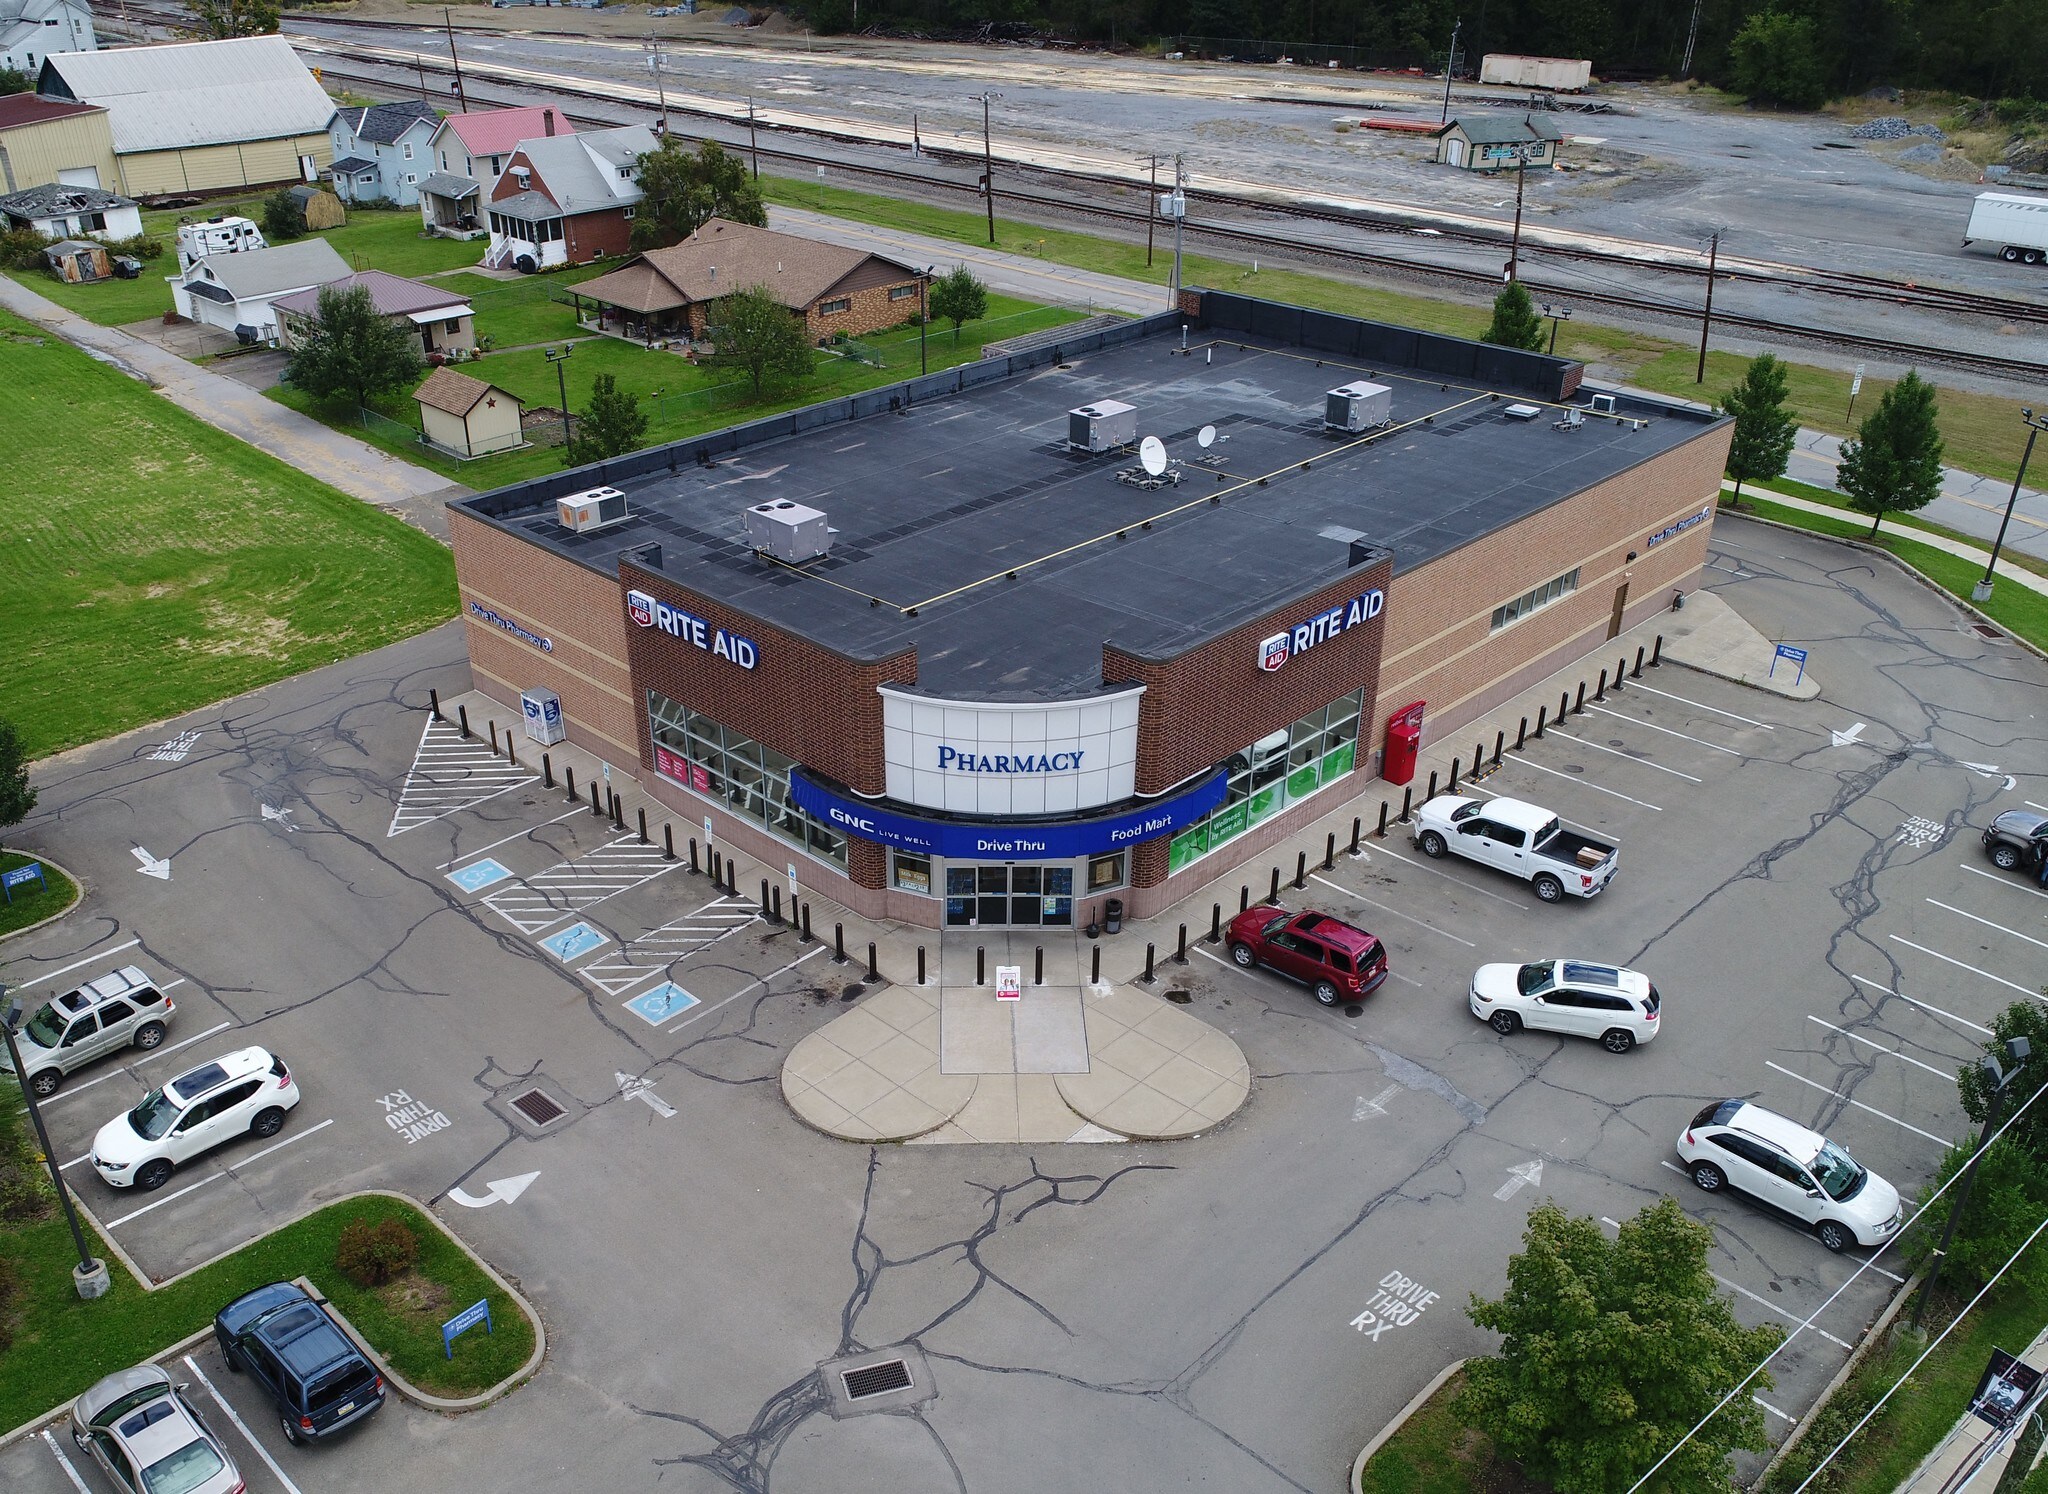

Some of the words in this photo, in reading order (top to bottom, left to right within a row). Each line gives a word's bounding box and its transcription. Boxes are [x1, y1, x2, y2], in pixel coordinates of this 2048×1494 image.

[1649, 533, 1664, 547] Drive
[1664, 527, 1677, 538] Thru
[1678, 514, 1703, 531] Pharmacy
[631, 595, 648, 610] RITE
[471, 603, 489, 620] Drive
[488, 611, 505, 628] Thru
[506, 620, 541, 648] Pharmacy
[634, 610, 648, 623] AID
[1294, 608, 1342, 655] RITE
[1346, 591, 1383, 630] AID
[657, 603, 707, 650] RITE
[713, 630, 755, 669] AID
[1268, 639, 1286, 654] RITE
[1268, 652, 1284, 667] AID
[830, 808, 874, 833] GNC
[879, 830, 899, 840] LIVE
[904, 836, 931, 846] WELL
[1111, 824, 1141, 841] Food
[1145, 815, 1172, 832] Mart
[1211, 832, 1219, 841] by
[1220, 824, 1232, 836] RITE
[1233, 818, 1242, 829] AID
[1213, 811, 1241, 830] Wellness
[1901, 822, 1941, 842] THRU
[977, 839, 1012, 851] Drive
[1014, 840, 1045, 851] Thru
[25, 872, 36, 880] AID
[375, 1089, 413, 1112] RX
[385, 1100, 435, 1130] THRU
[397, 1111, 452, 1144] DRIVE
[1378, 1270, 1441, 1312] DRIVE
[456, 1315, 470, 1327] Drive
[470, 1306, 484, 1317] Thru
[1366, 1288, 1420, 1326] THRU
[456, 1312, 484, 1332] Pharmacy
[1350, 1310, 1394, 1342] RX
